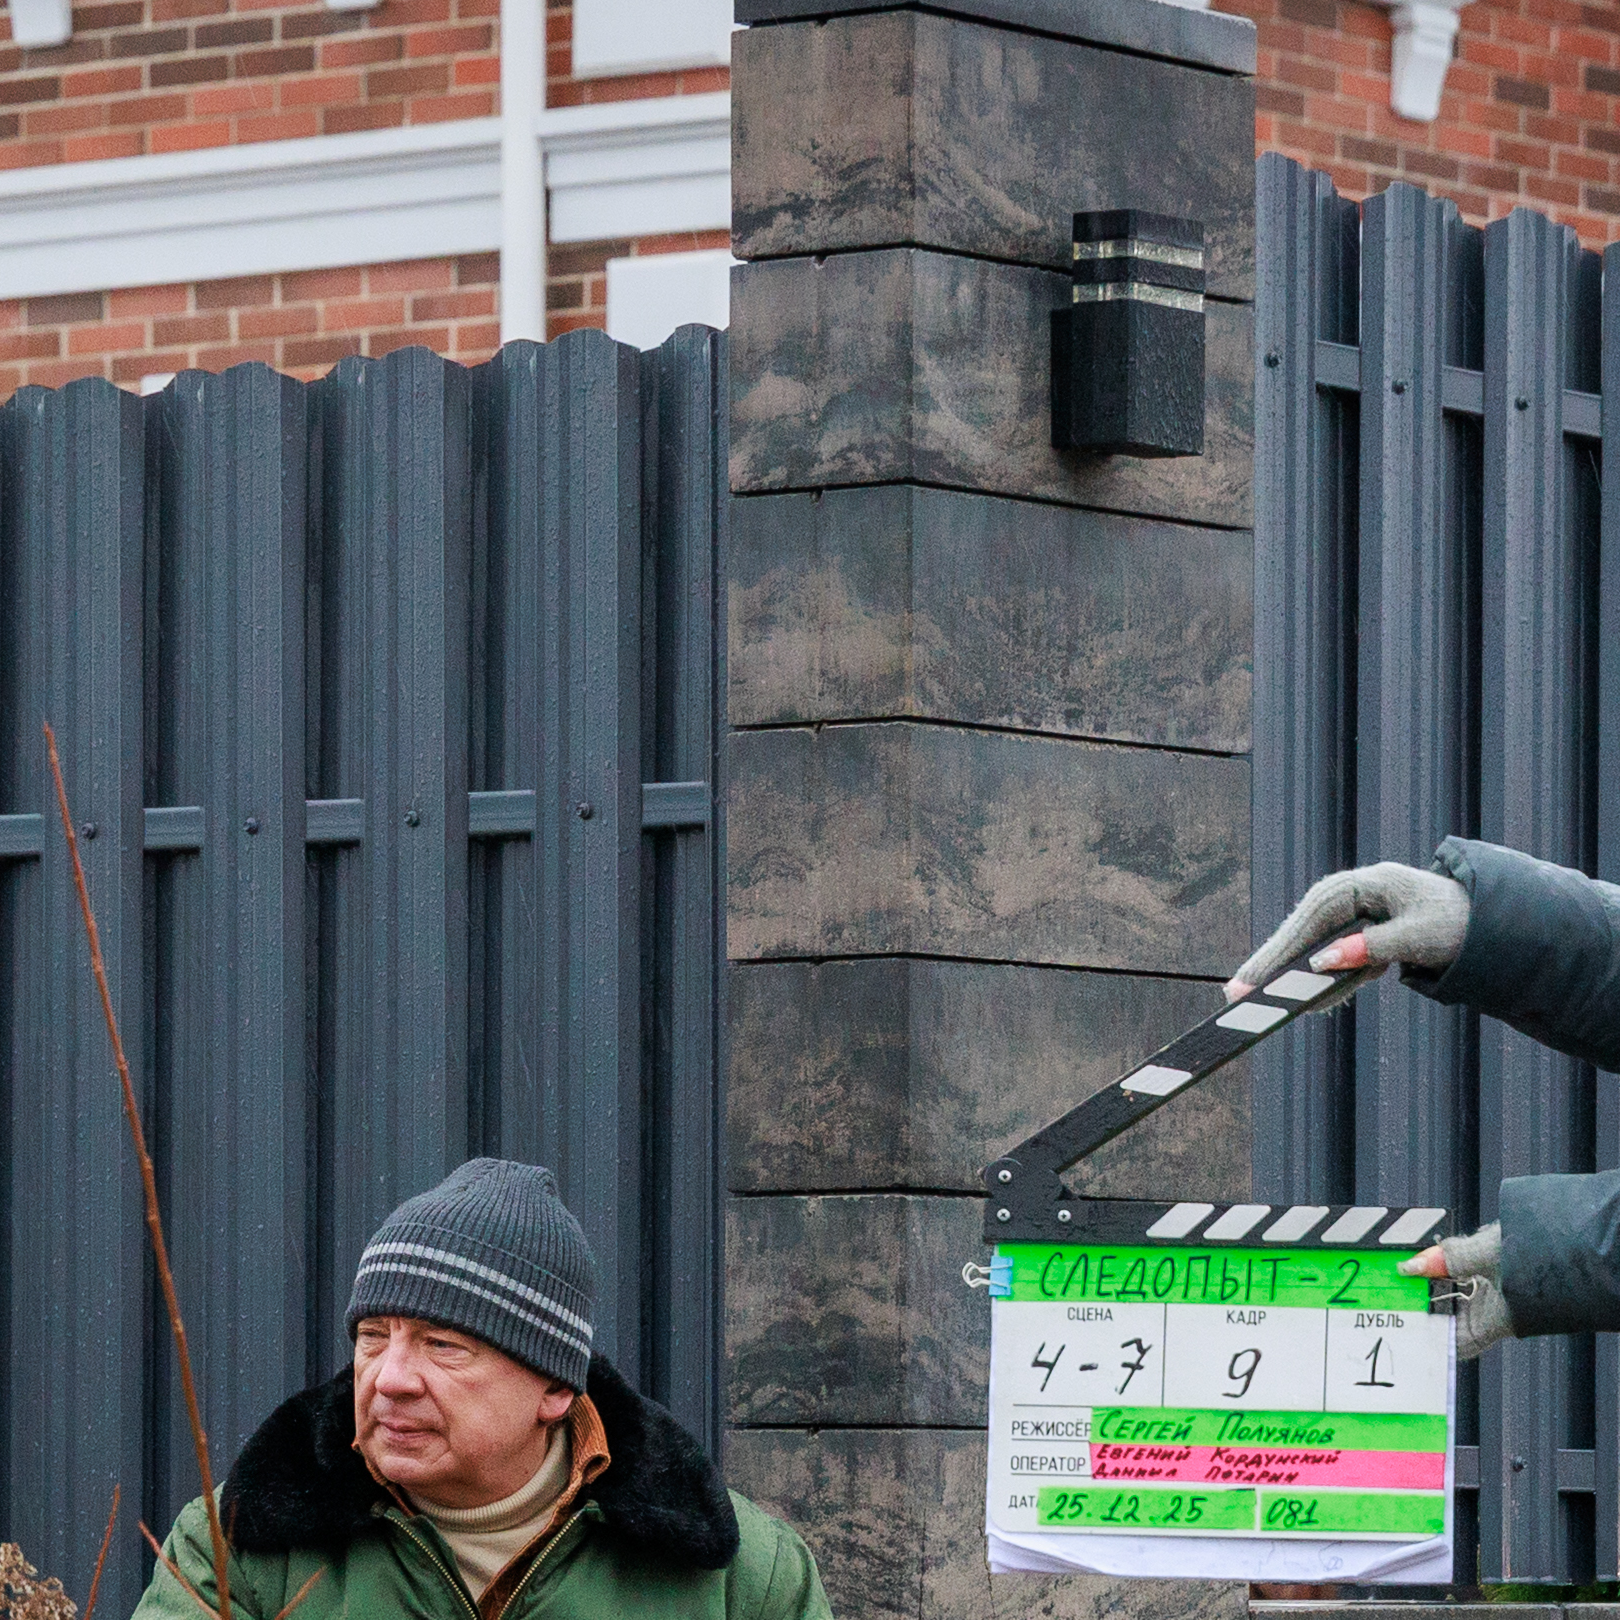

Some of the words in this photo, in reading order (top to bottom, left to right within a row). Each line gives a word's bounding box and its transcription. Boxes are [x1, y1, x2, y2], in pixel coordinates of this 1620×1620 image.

[1067, 1307, 1114, 1322] СЦЕНА
[1226, 1310, 1267, 1325] КАДР
[1354, 1313, 1405, 1329] ДУБЛЬ
[1353, 1336, 1395, 1388] 1
[1221, 1348, 1262, 1399] 9
[1011, 1418, 1092, 1437] РЕЖИССЁР
[1010, 1455, 1086, 1472] ОПЕРАТОР
[1008, 1494, 1038, 1509] ДАТ
[1266, 1498, 1319, 1528] 081
